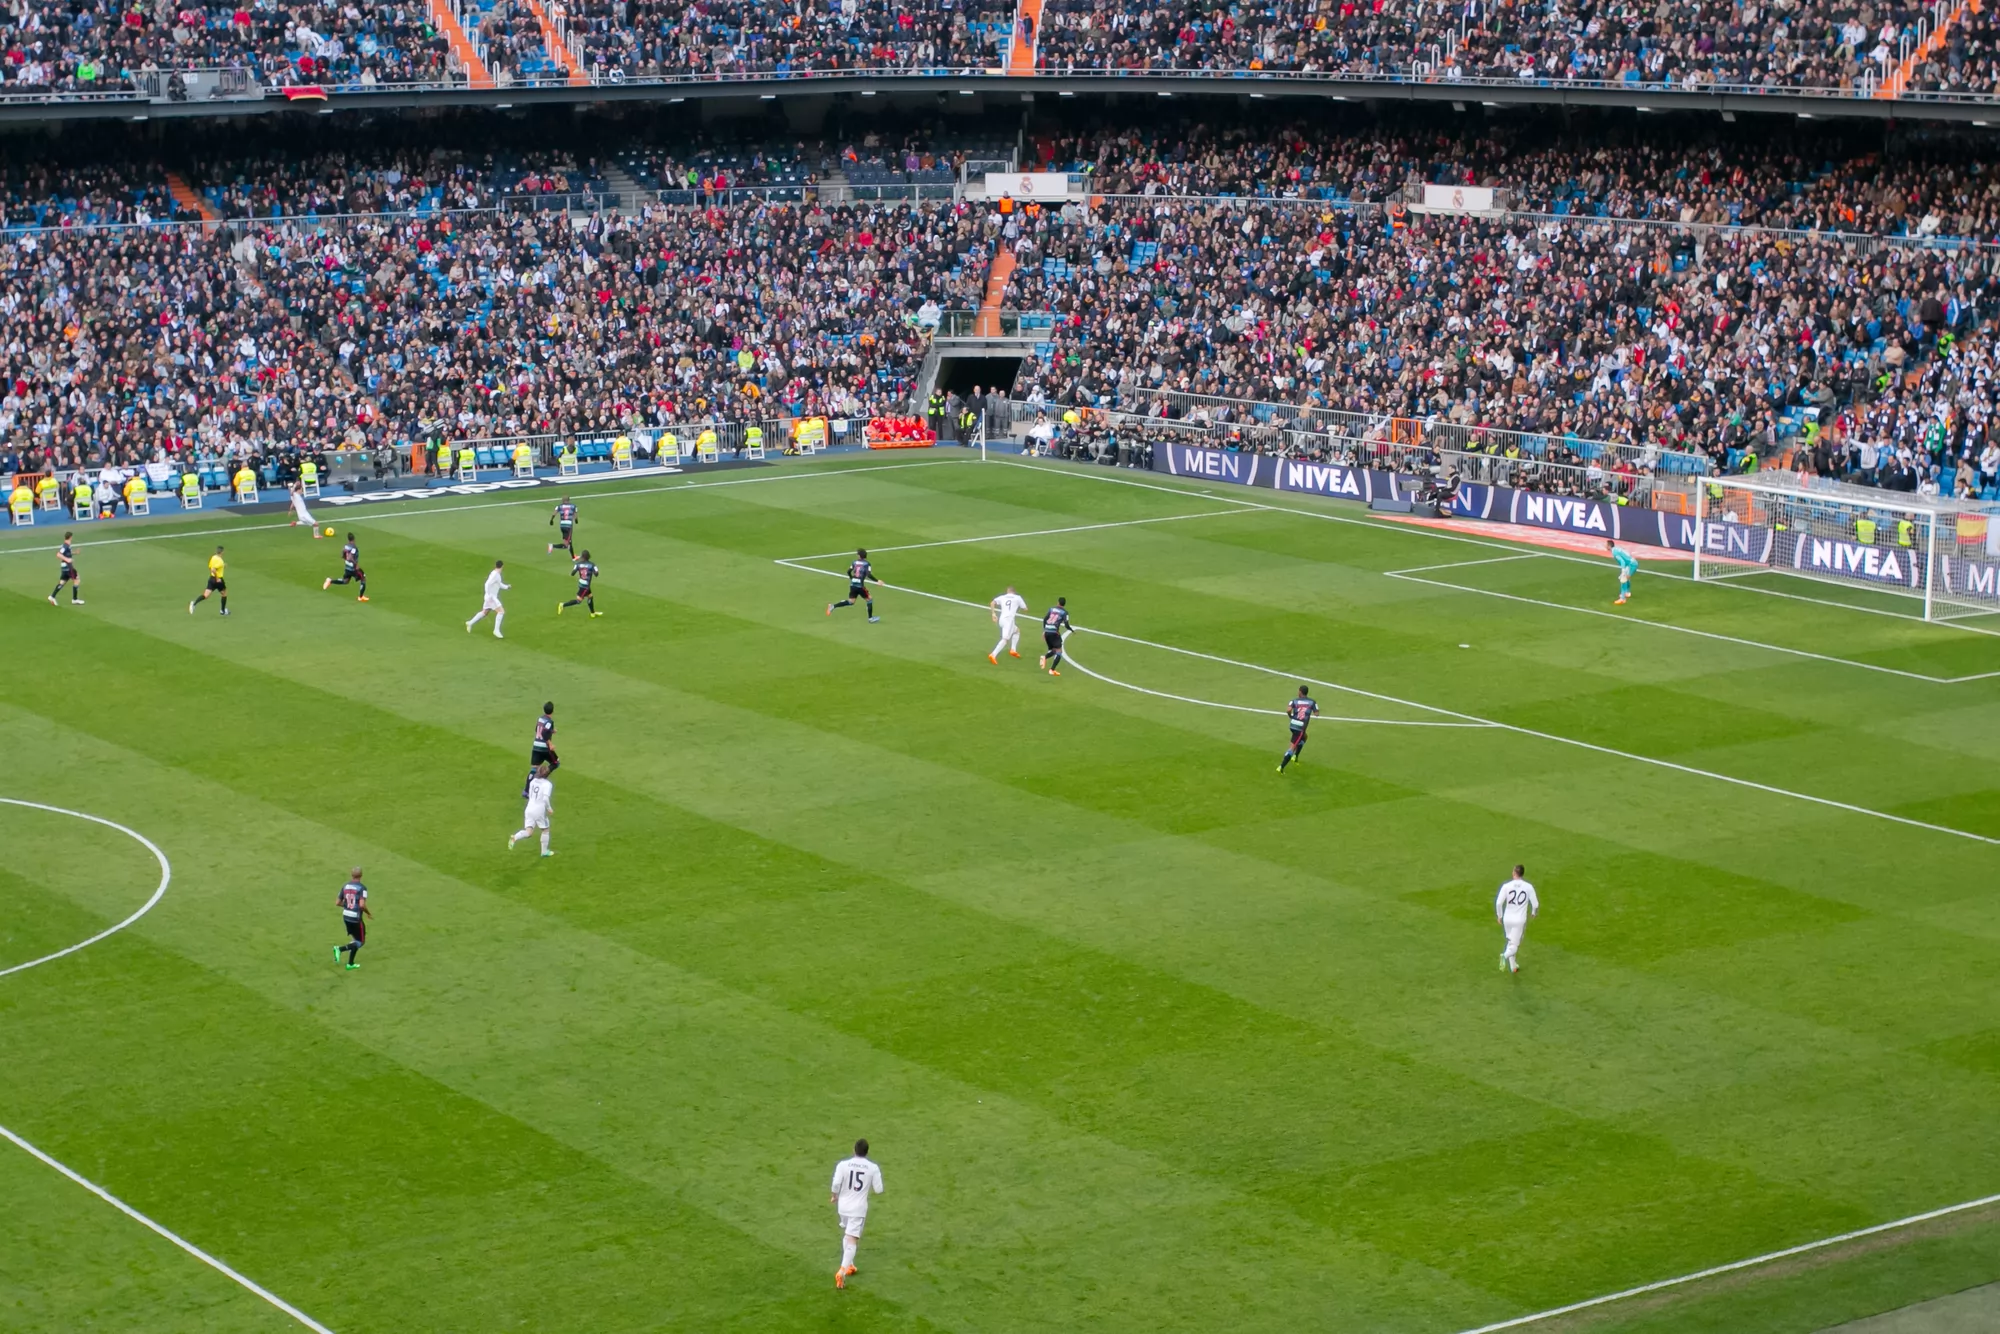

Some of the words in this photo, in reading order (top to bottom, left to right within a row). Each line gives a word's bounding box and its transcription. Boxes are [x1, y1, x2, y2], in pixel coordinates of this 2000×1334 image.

[1184, 448, 1239, 478] MEN
[1289, 462, 1360, 496] NIVEA
[1526, 496, 1607, 532] NIVEA
[1812, 537, 1903, 580] NIVEA
[1005, 599, 1012, 611] 9
[1508, 890, 1527, 905] 20
[848, 1170, 865, 1192] 15
